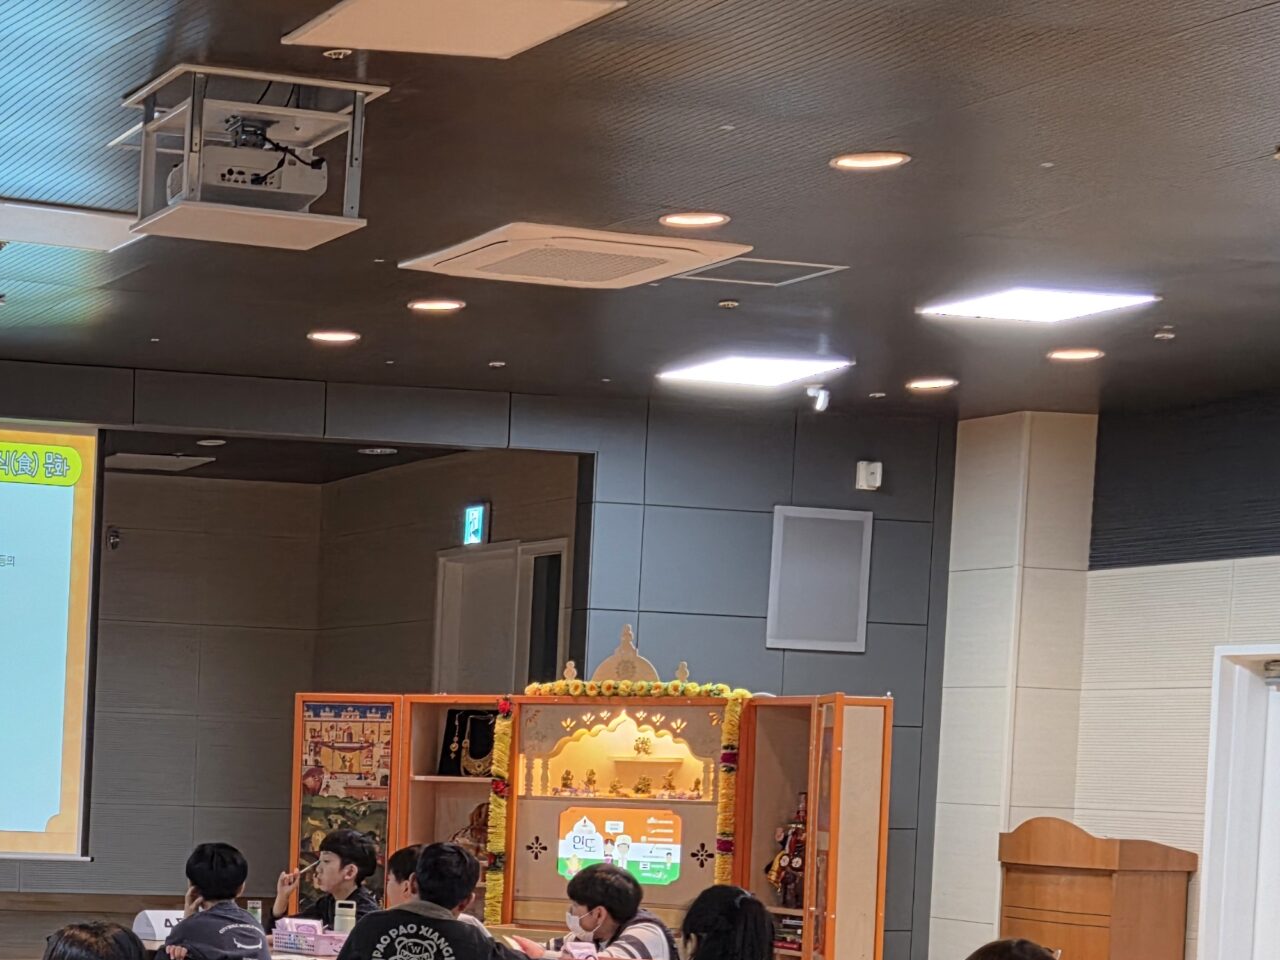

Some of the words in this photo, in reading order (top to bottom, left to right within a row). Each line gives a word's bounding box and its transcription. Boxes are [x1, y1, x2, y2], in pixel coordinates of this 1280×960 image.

[43, 451, 70, 478] 문화
[0, 554, 16, 567] 등의
[572, 835, 596, 853] 인도
[388, 923, 417, 938] PAO
